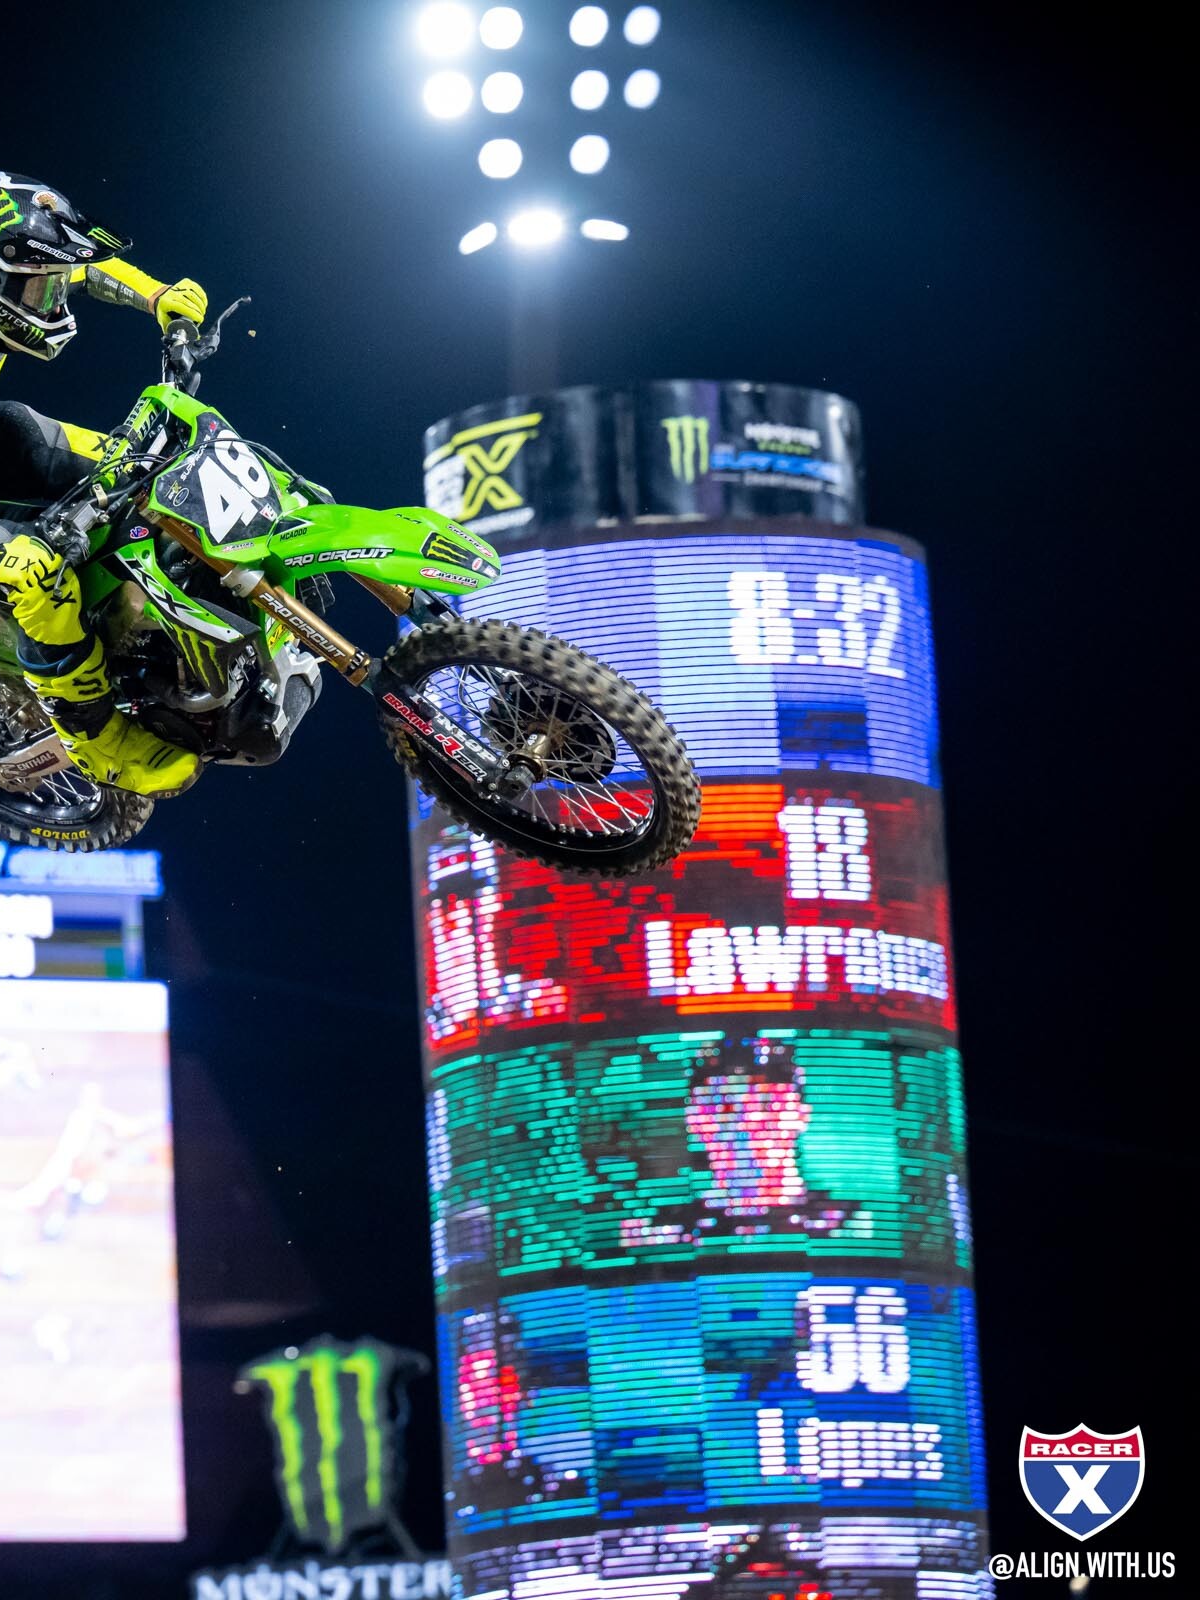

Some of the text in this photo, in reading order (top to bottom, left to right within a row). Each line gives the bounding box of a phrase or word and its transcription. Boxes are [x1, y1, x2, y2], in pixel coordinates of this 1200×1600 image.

[198, 429, 271, 544] 48
[279, 527, 308, 542] MCADOO
[284, 547, 394, 567] PRO CIRCUIT
[259, 592, 346, 659] PRO CIRCUIT
[382, 692, 435, 736] BRAKING
[31, 826, 88, 841] DUNLOP
[195, 1559, 450, 1600] MONSTER
